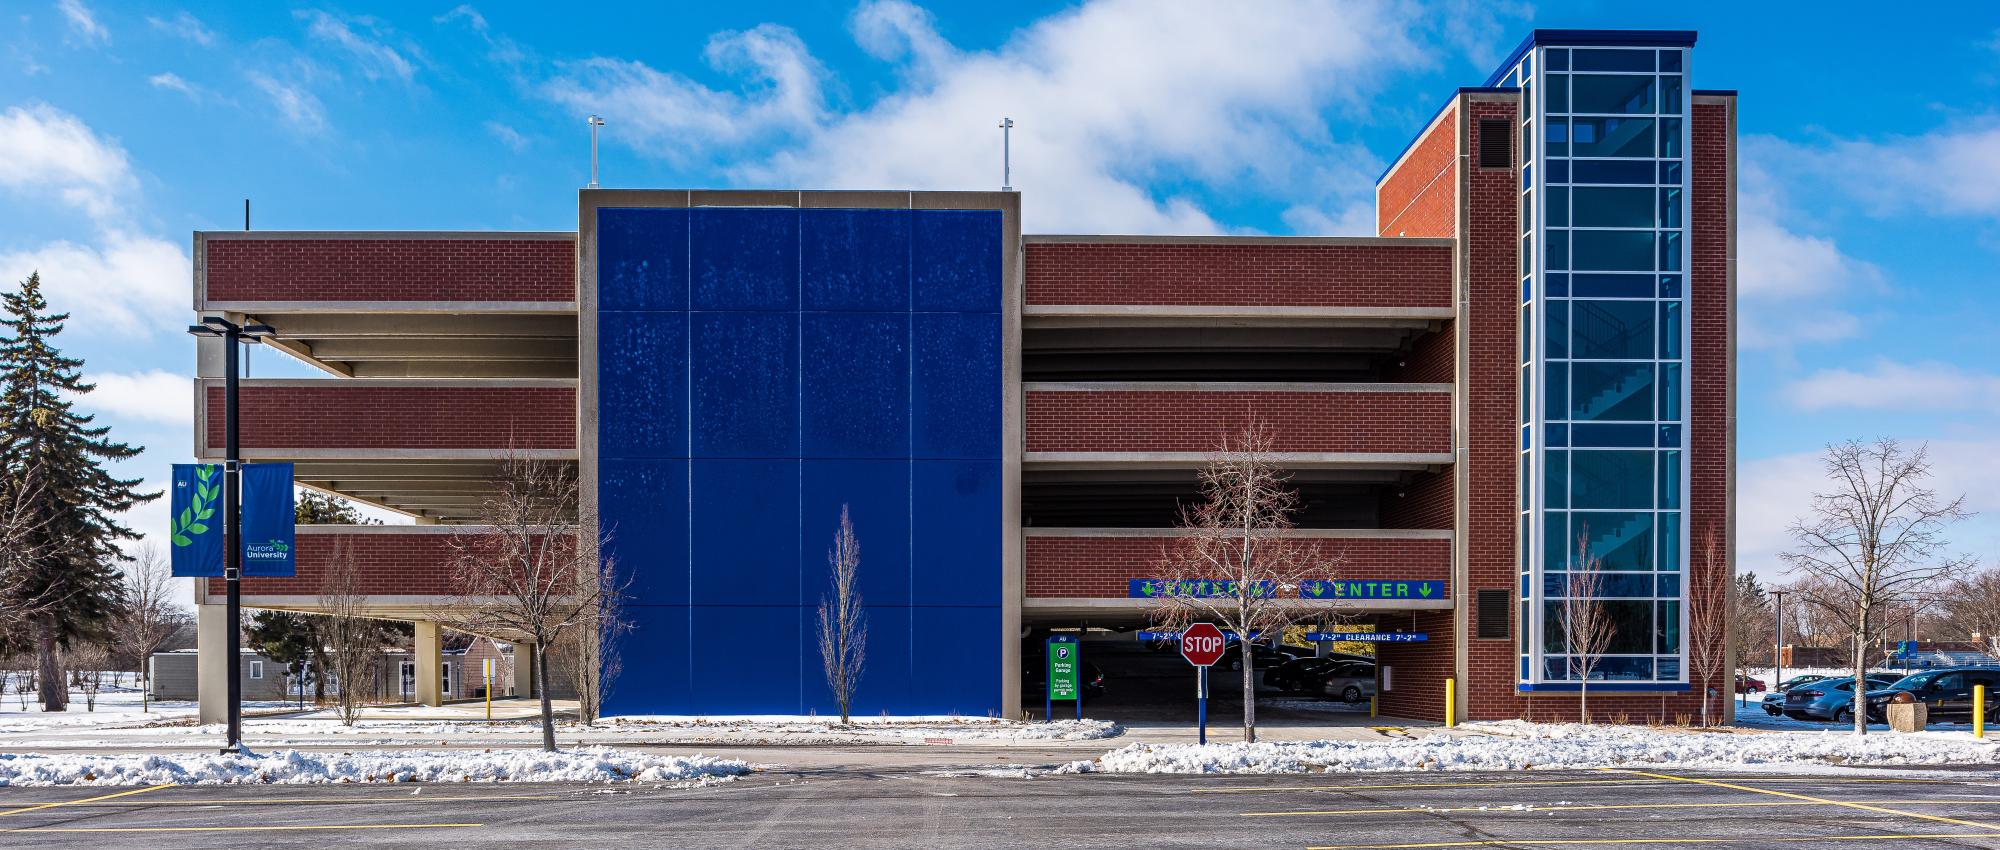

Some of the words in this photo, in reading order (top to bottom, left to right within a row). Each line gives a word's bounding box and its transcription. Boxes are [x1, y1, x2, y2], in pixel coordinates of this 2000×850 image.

[247, 551, 287, 559] University
[1335, 583, 1408, 597] ENTER
[1184, 636, 1222, 653] STOP
[1060, 649, 1067, 657] P
